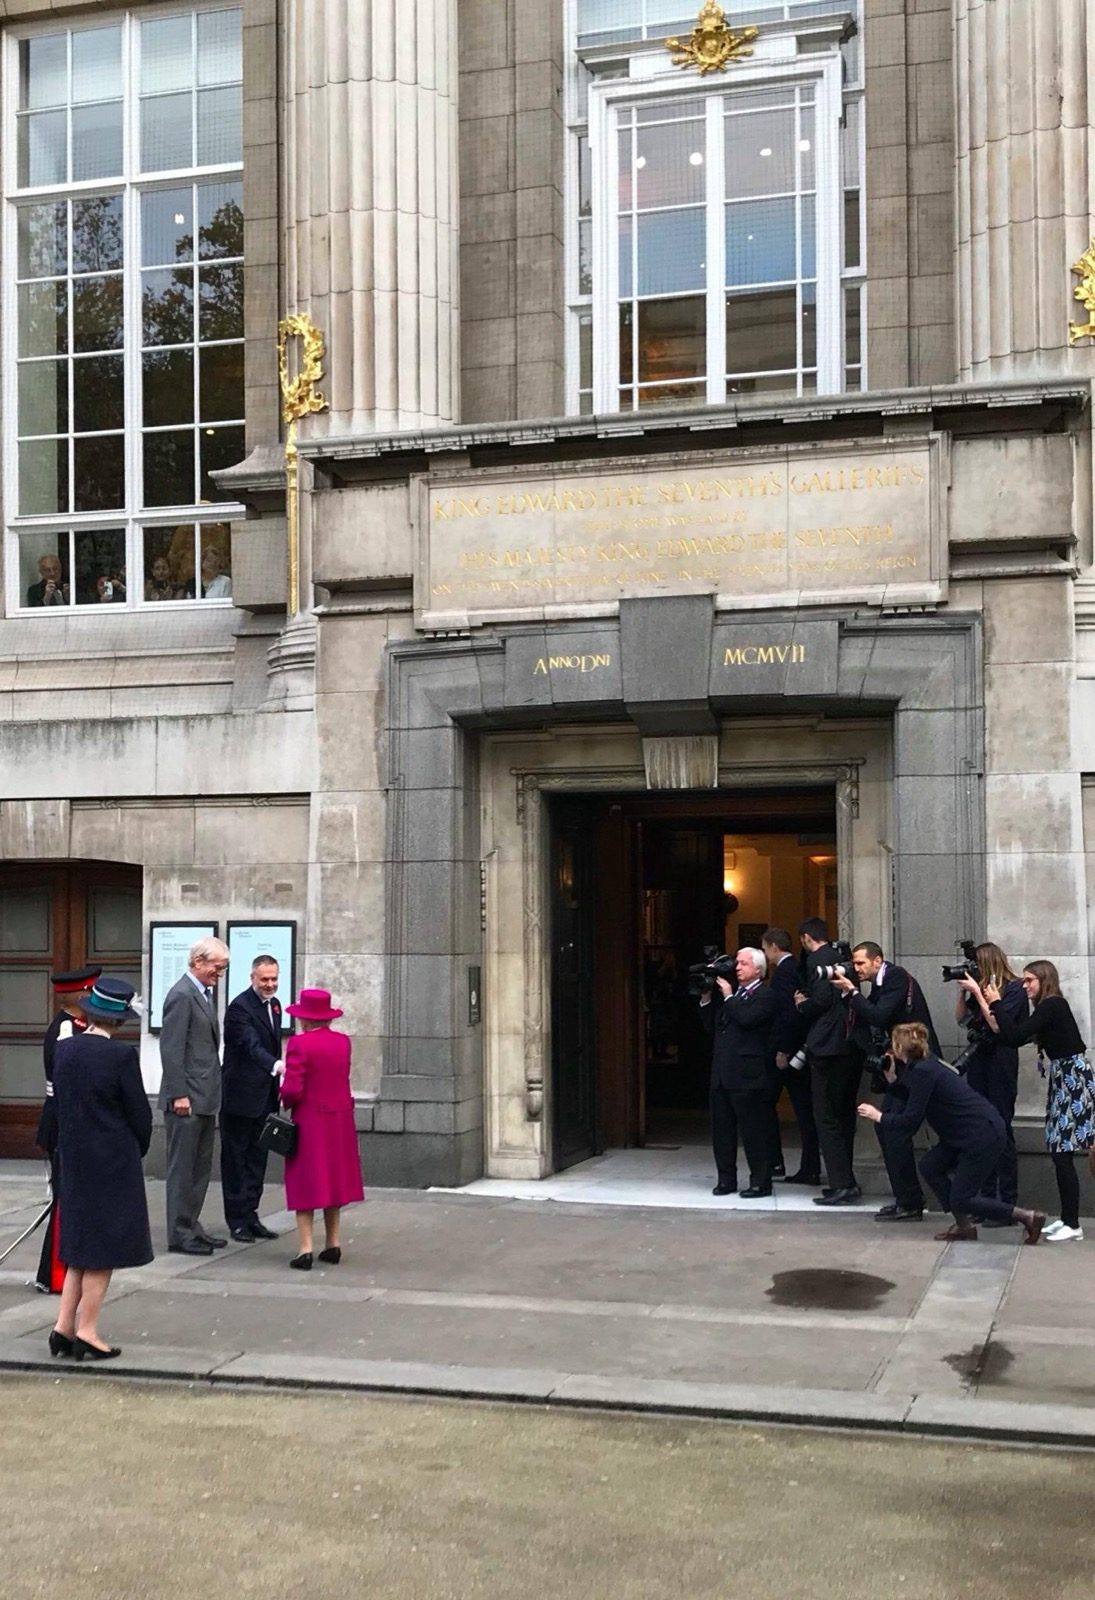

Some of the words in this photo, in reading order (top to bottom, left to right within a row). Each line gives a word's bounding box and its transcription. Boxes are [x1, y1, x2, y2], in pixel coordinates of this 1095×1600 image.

[434, 495, 490, 520] KING
[495, 487, 597, 516] EDWARD
[600, 485, 648, 507] THE
[657, 473, 784, 503] SEVENTH'S
[790, 465, 925, 496] GALLERIES
[503, 545, 589, 567] MAJESTY
[597, 543, 650, 565] KING
[657, 535, 745, 560] EDWARD
[795, 524, 893, 548] SEVENTH
[723, 644, 805, 666] MCMVII
